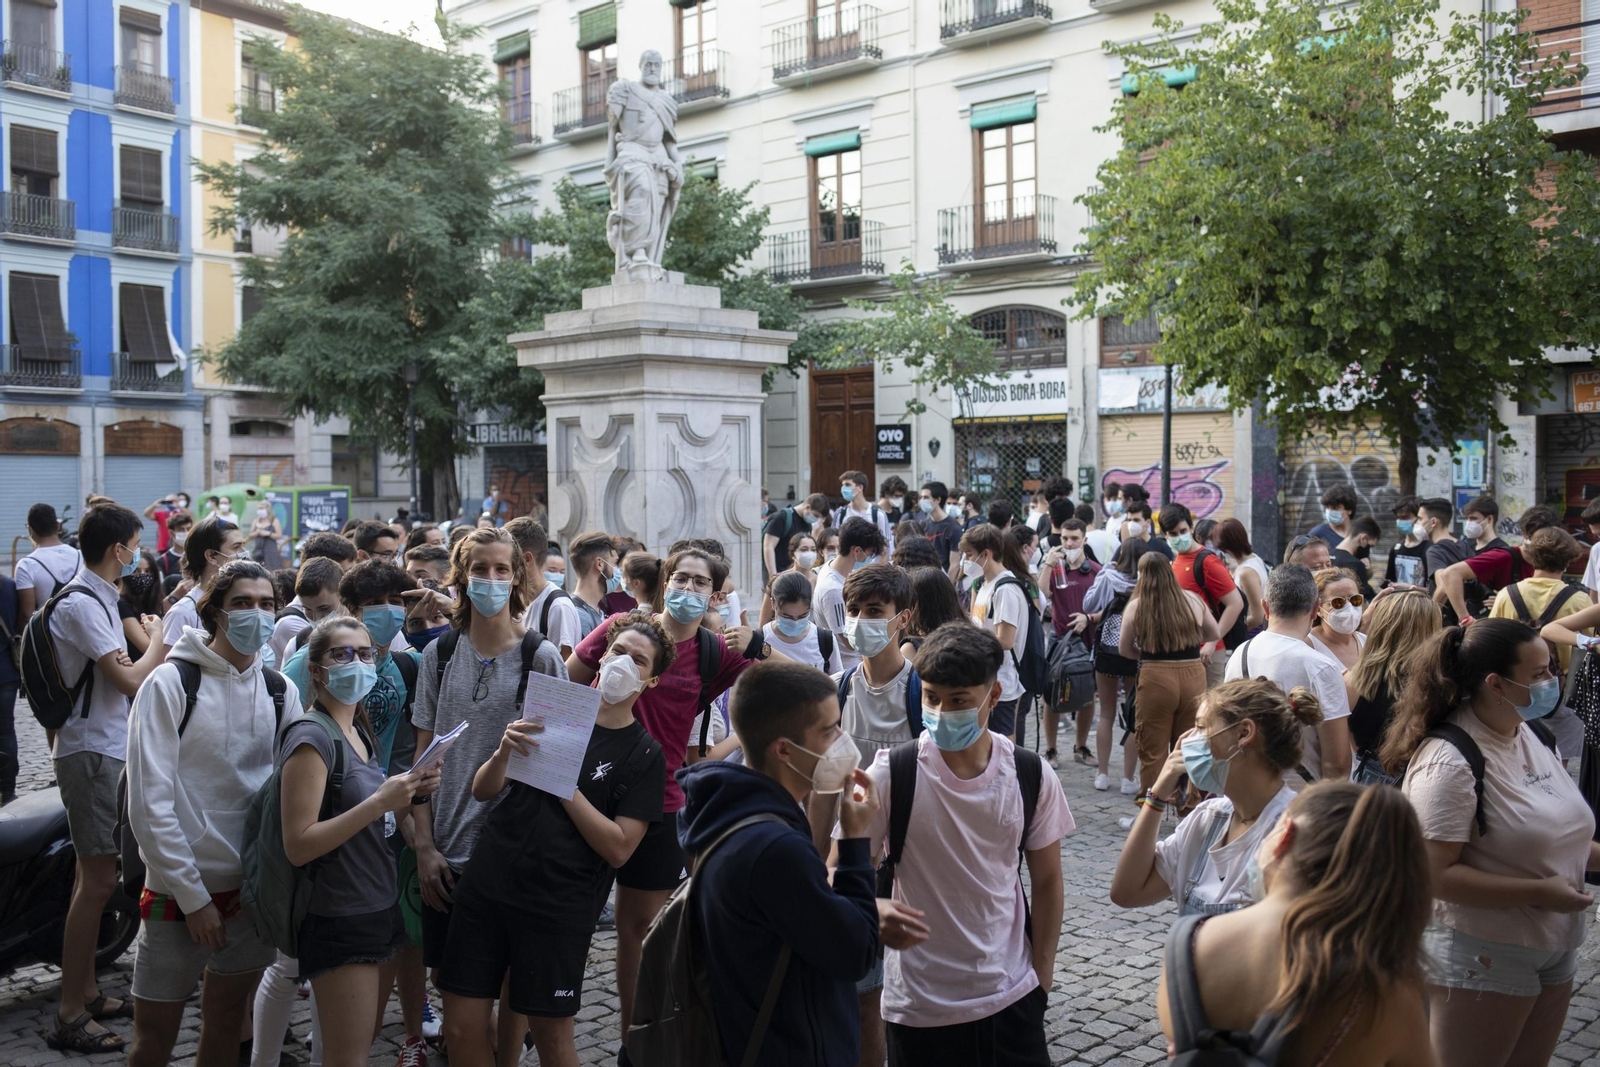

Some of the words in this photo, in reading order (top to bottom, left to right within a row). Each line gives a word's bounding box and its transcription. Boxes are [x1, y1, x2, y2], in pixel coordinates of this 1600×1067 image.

[972, 384, 1007, 403] DISCOS
[1578, 401, 1594, 412] 667
[877, 429, 905, 442] OYO
[879, 444, 902, 452] HOSTAL
